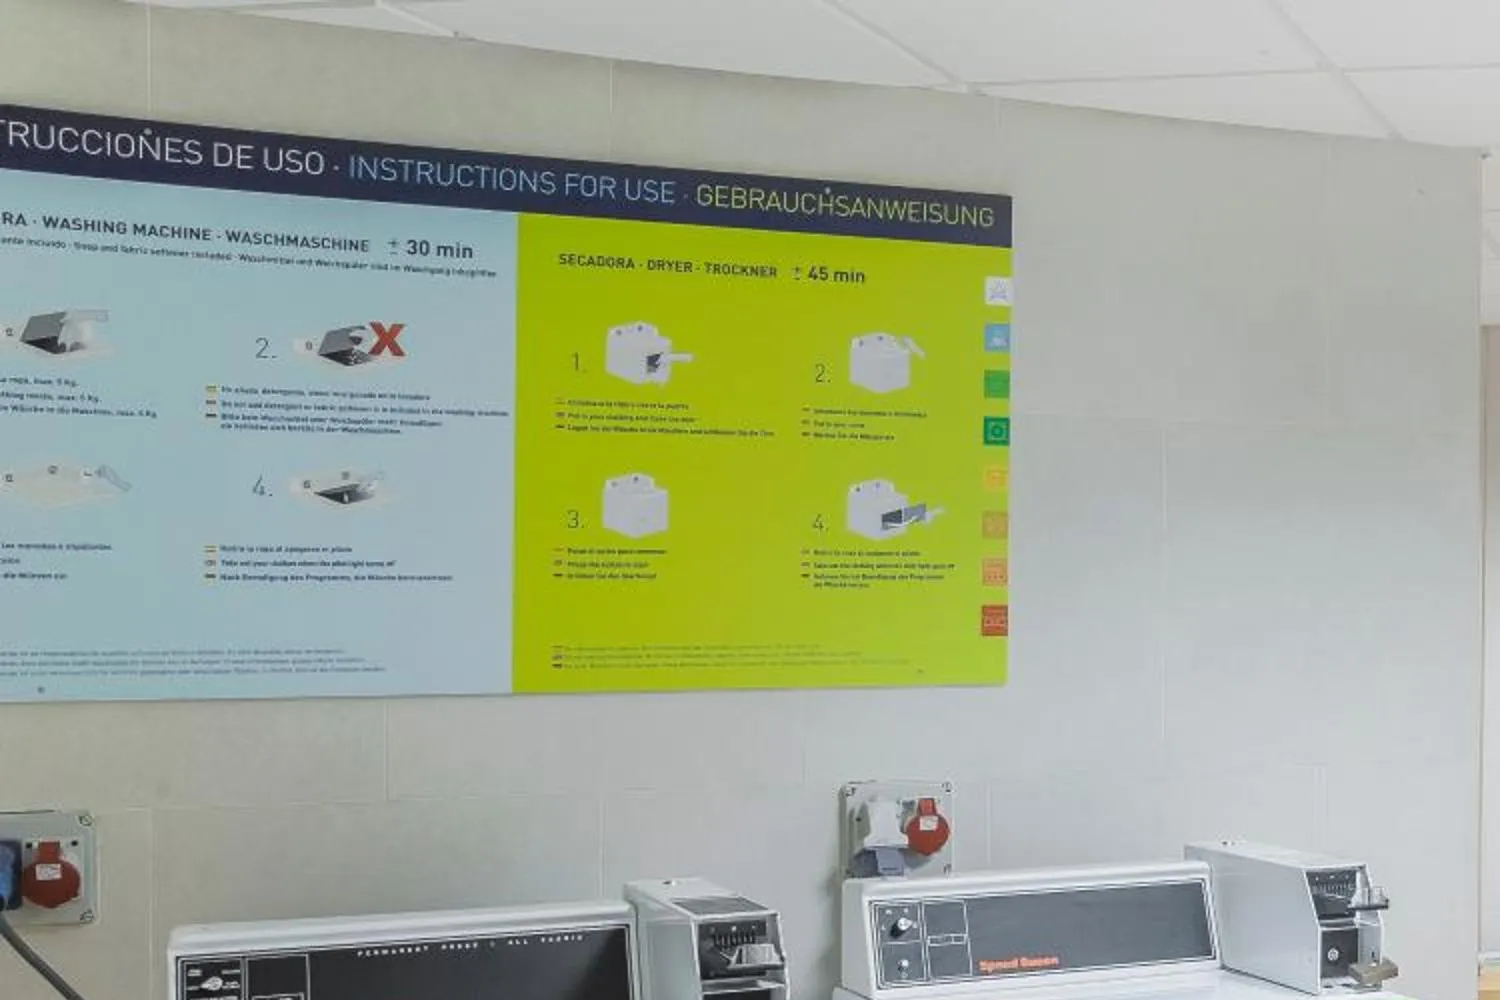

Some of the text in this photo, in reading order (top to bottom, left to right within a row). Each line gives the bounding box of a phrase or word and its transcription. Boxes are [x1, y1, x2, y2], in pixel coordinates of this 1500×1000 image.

[213, 142, 253, 170] DE
[263, 147, 325, 176] USO
[349, 154, 556, 196] INSTRUCTIONS
[565, 172, 616, 201] FOR
[625, 178, 676, 204] USE
[696, 184, 995, 228] GEBRAUCHSANWEISUNG
[42, 215, 127, 235] WASHING
[133, 223, 211, 241] MACHINE
[226, 231, 369, 253] WASCHMASCHINE
[406, 239, 430, 256] 30
[436, 241, 473, 259] min
[559, 253, 635, 270] SECADORA
[647, 258, 693, 274] DRYER
[704, 261, 777, 279] TROCKNER
[807, 265, 829, 283] 45
[833, 266, 866, 284] min
[255, 337, 278, 359] 2.
[567, 509, 585, 529] 3.
